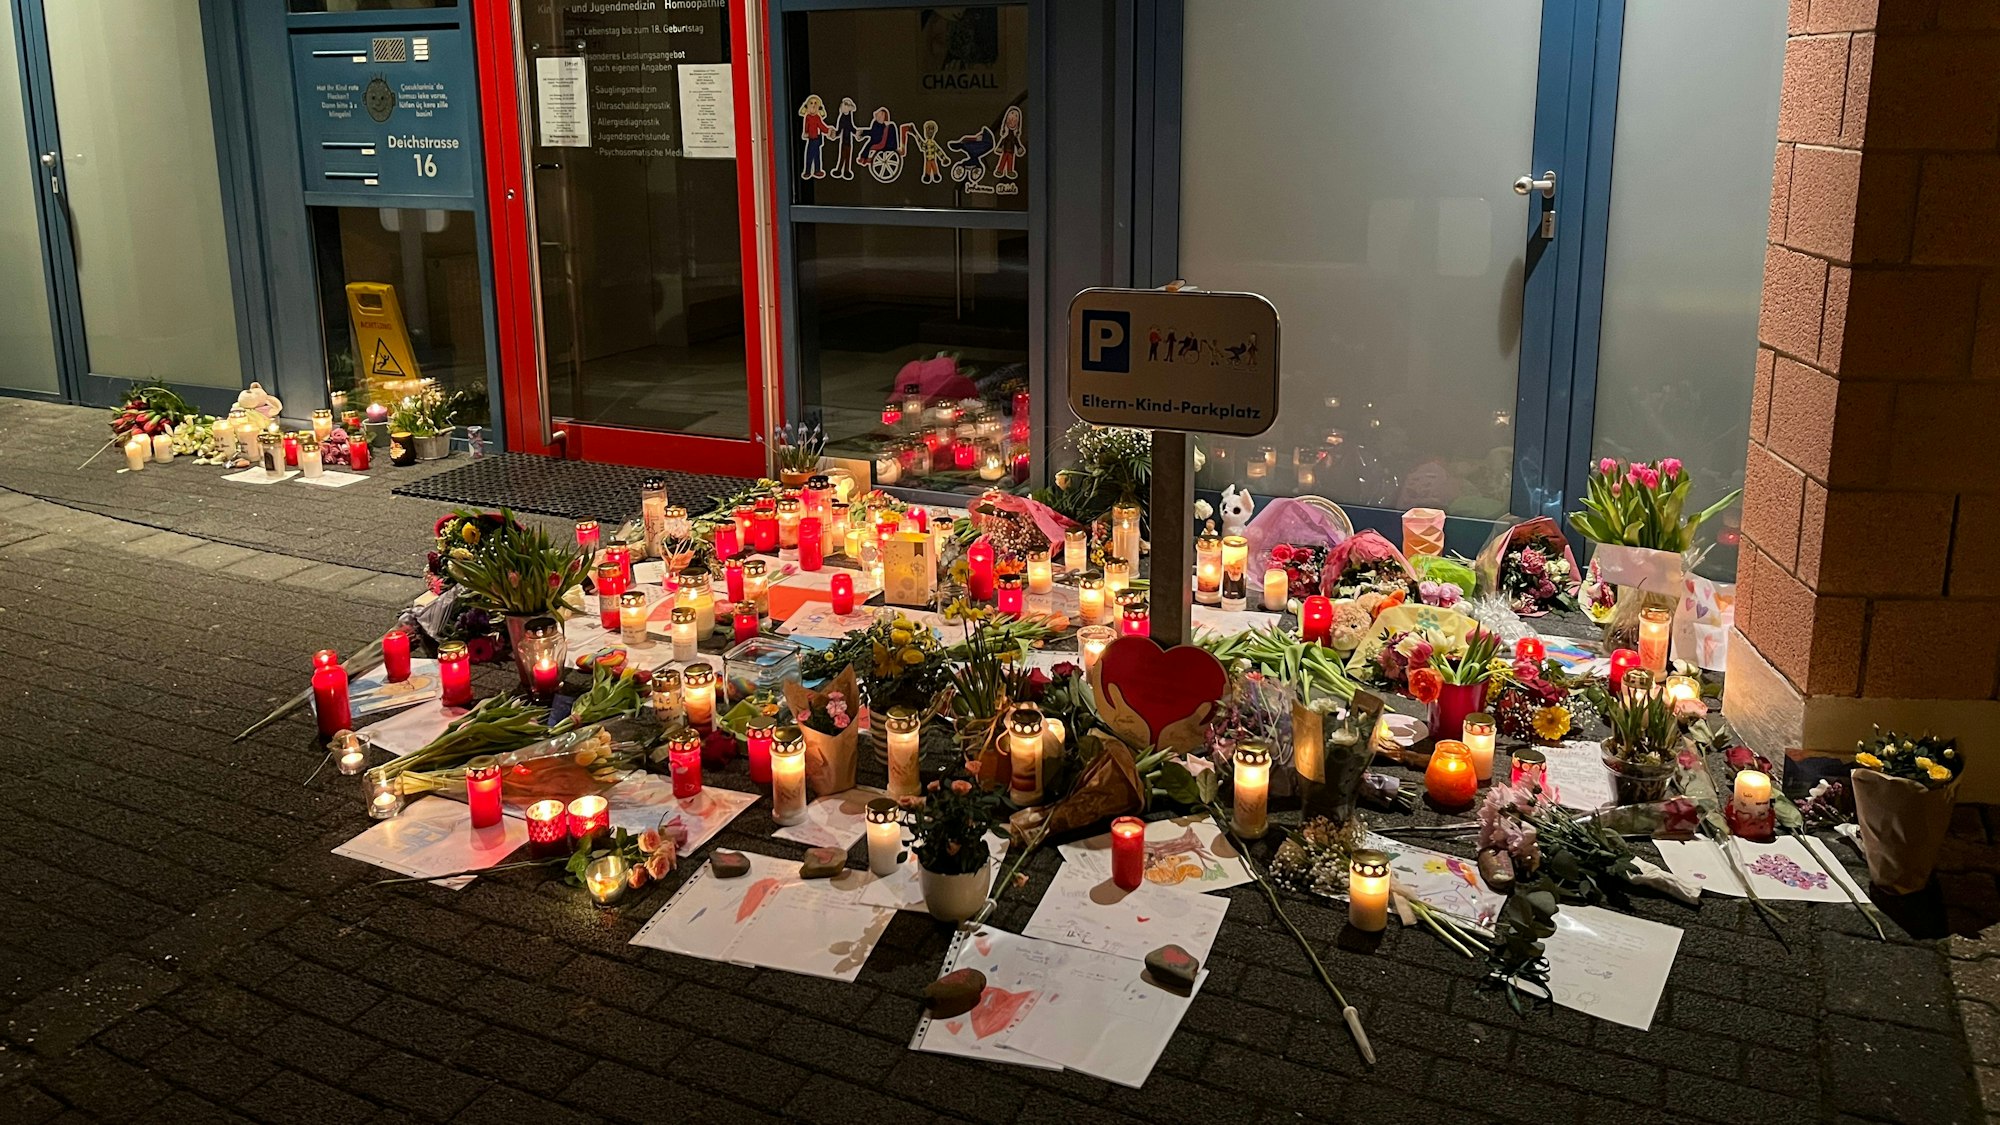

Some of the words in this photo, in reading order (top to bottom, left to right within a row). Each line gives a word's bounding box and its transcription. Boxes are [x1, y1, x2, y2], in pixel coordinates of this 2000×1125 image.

[571, 3, 588, 13] und
[589, 1, 656, 15] Jugendmedizin
[584, 25, 620, 37] Lebenstag
[621, 25, 633, 36] bis
[633, 27, 650, 36] zum
[650, 24, 663, 34] 18.
[663, 23, 704, 35] Geburtstag
[621, 50, 686, 62] Leistungsangebot
[593, 63, 611, 73] nach
[611, 64, 640, 75] eigenen
[640, 62, 673, 74] Angaben
[922, 73, 999, 91] CHAGALL
[595, 101, 671, 113] Ultraschalldiagnostik
[597, 117, 660, 129] Allergiediagnostik
[388, 135, 460, 149] Deichstrasse
[597, 131, 671, 143] Jugendsprechstunde
[599, 146, 664, 158] Psychosomatische
[413, 153, 438, 178] 16
[1088, 319, 1125, 362] P
[1082, 394, 1261, 420] Eltern-Kind-Parkplatz
